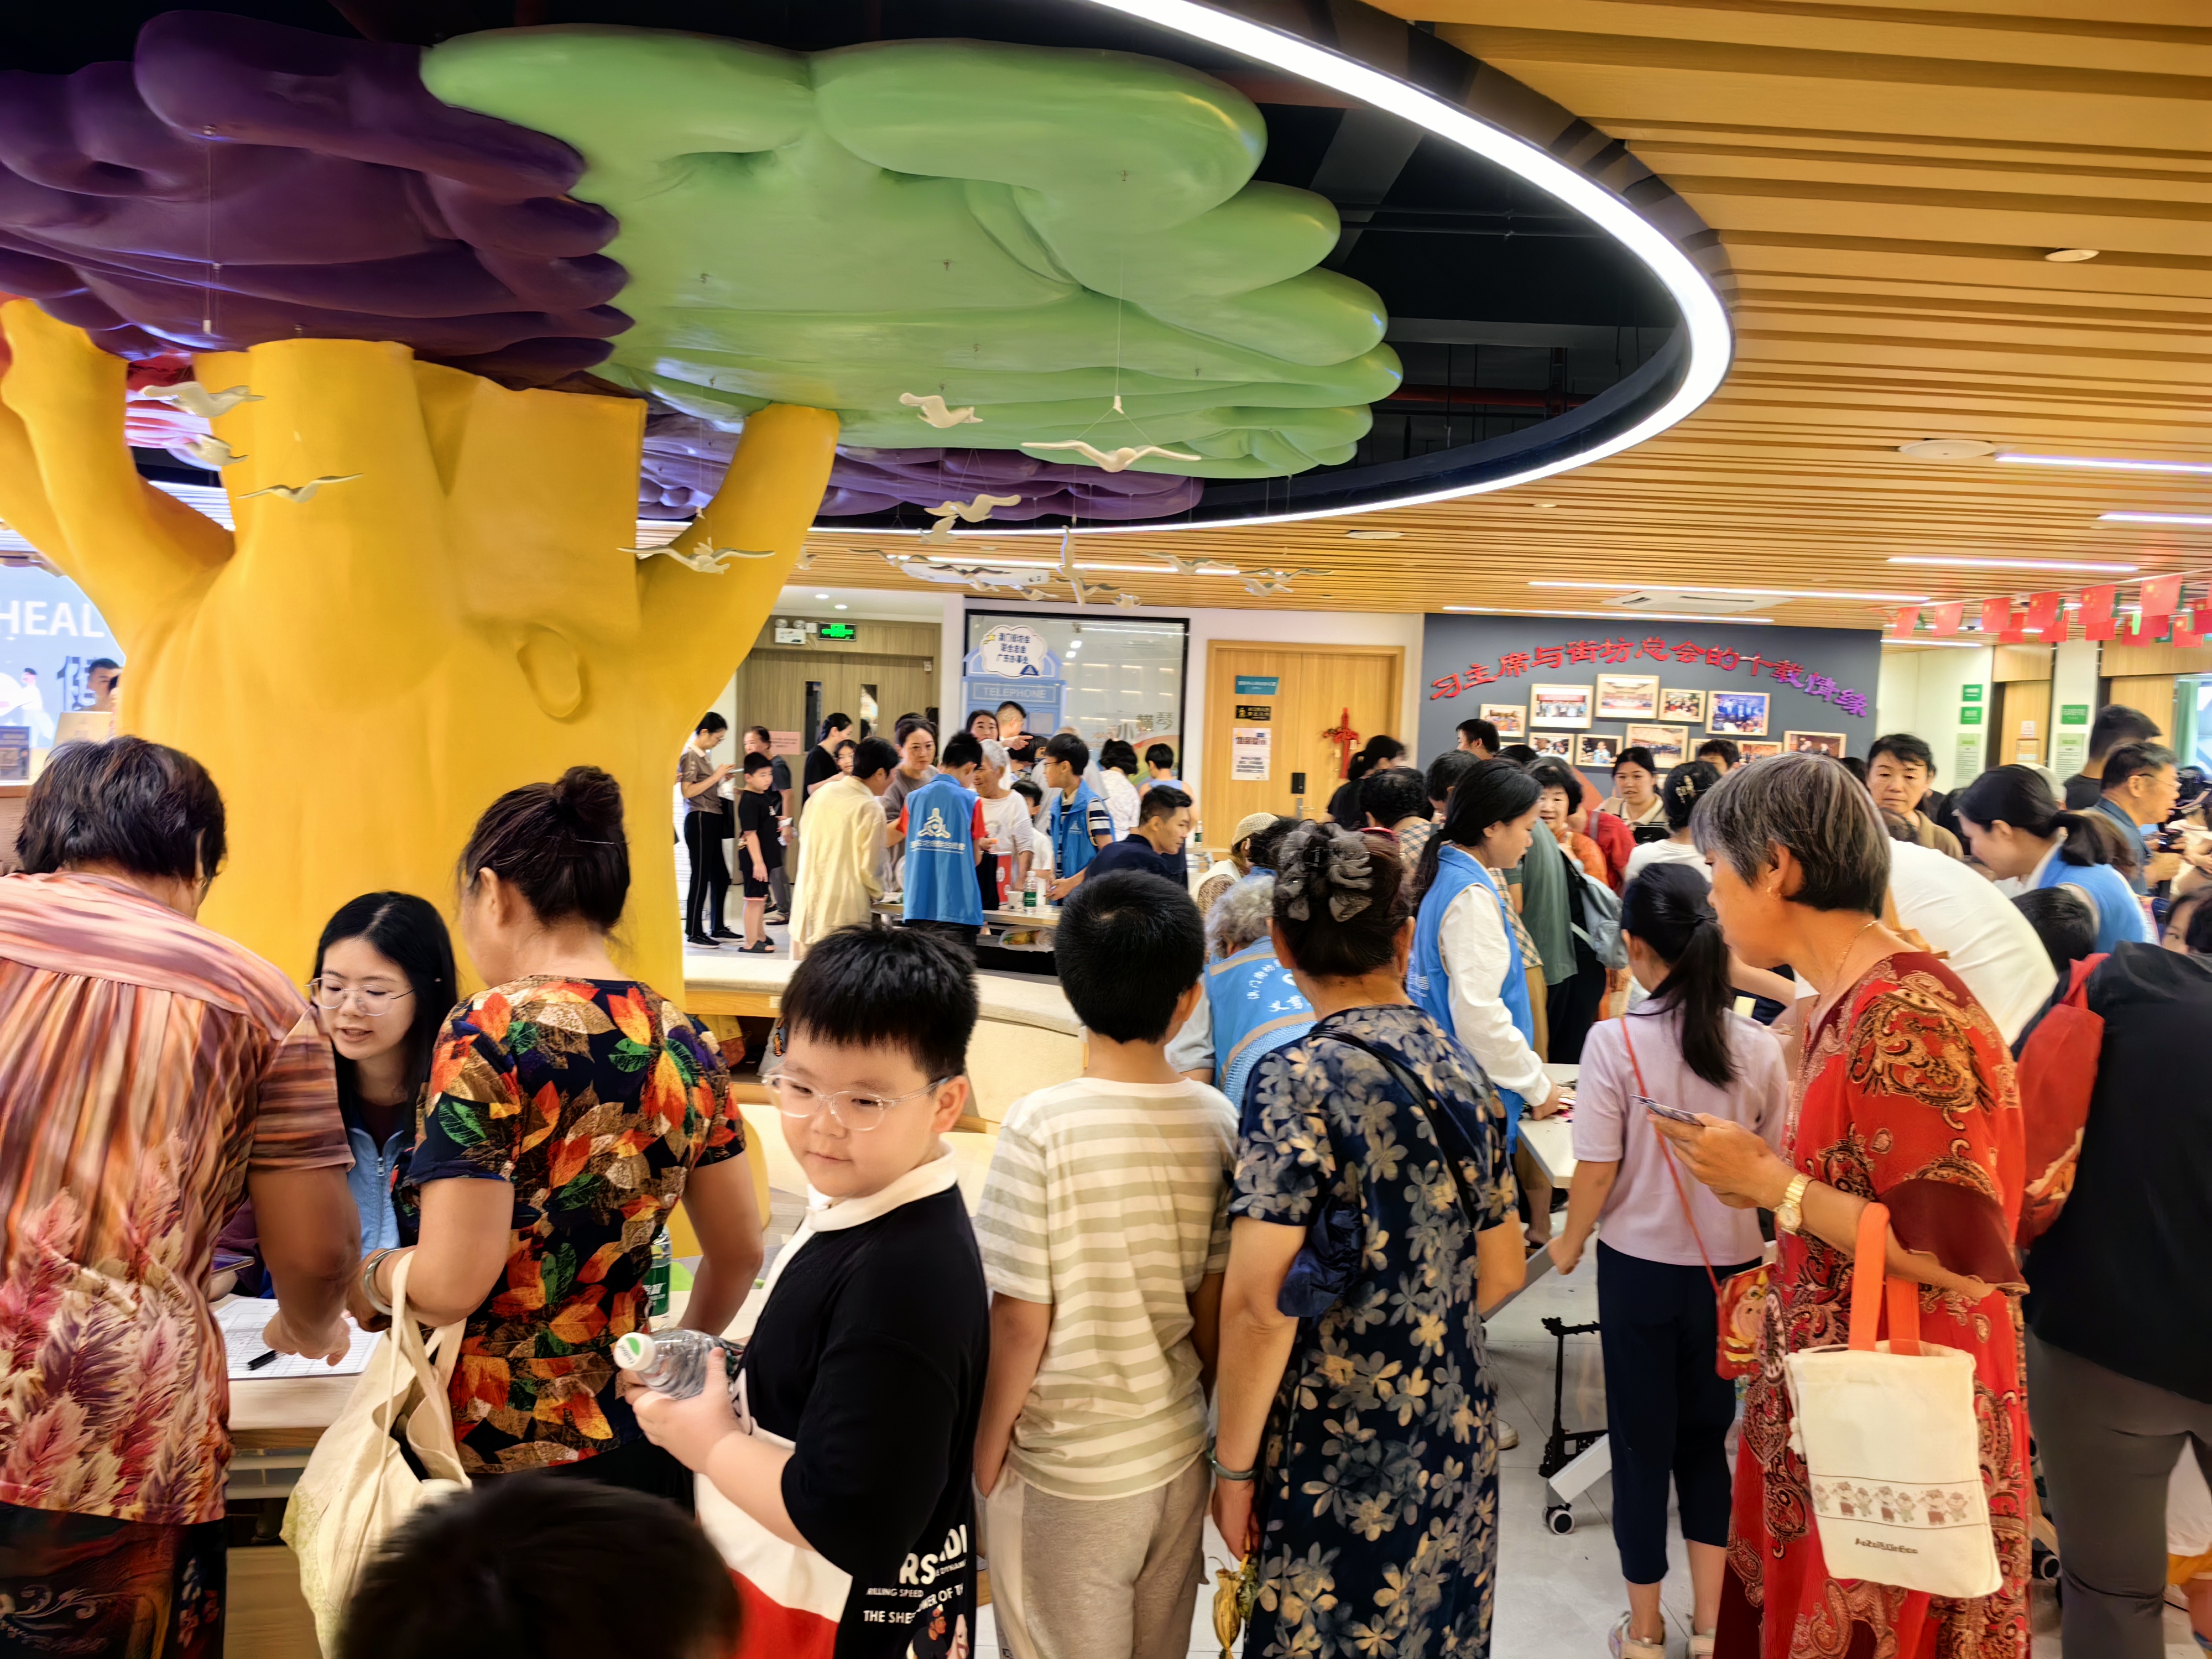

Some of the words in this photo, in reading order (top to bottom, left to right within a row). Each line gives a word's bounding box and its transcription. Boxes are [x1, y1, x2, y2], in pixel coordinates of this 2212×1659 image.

[983, 687, 1046, 698] TELEPHONE
[899, 1589, 924, 1598] SPEED
[863, 1610, 886, 1623] THE
[938, 1587, 954, 1602] OF
